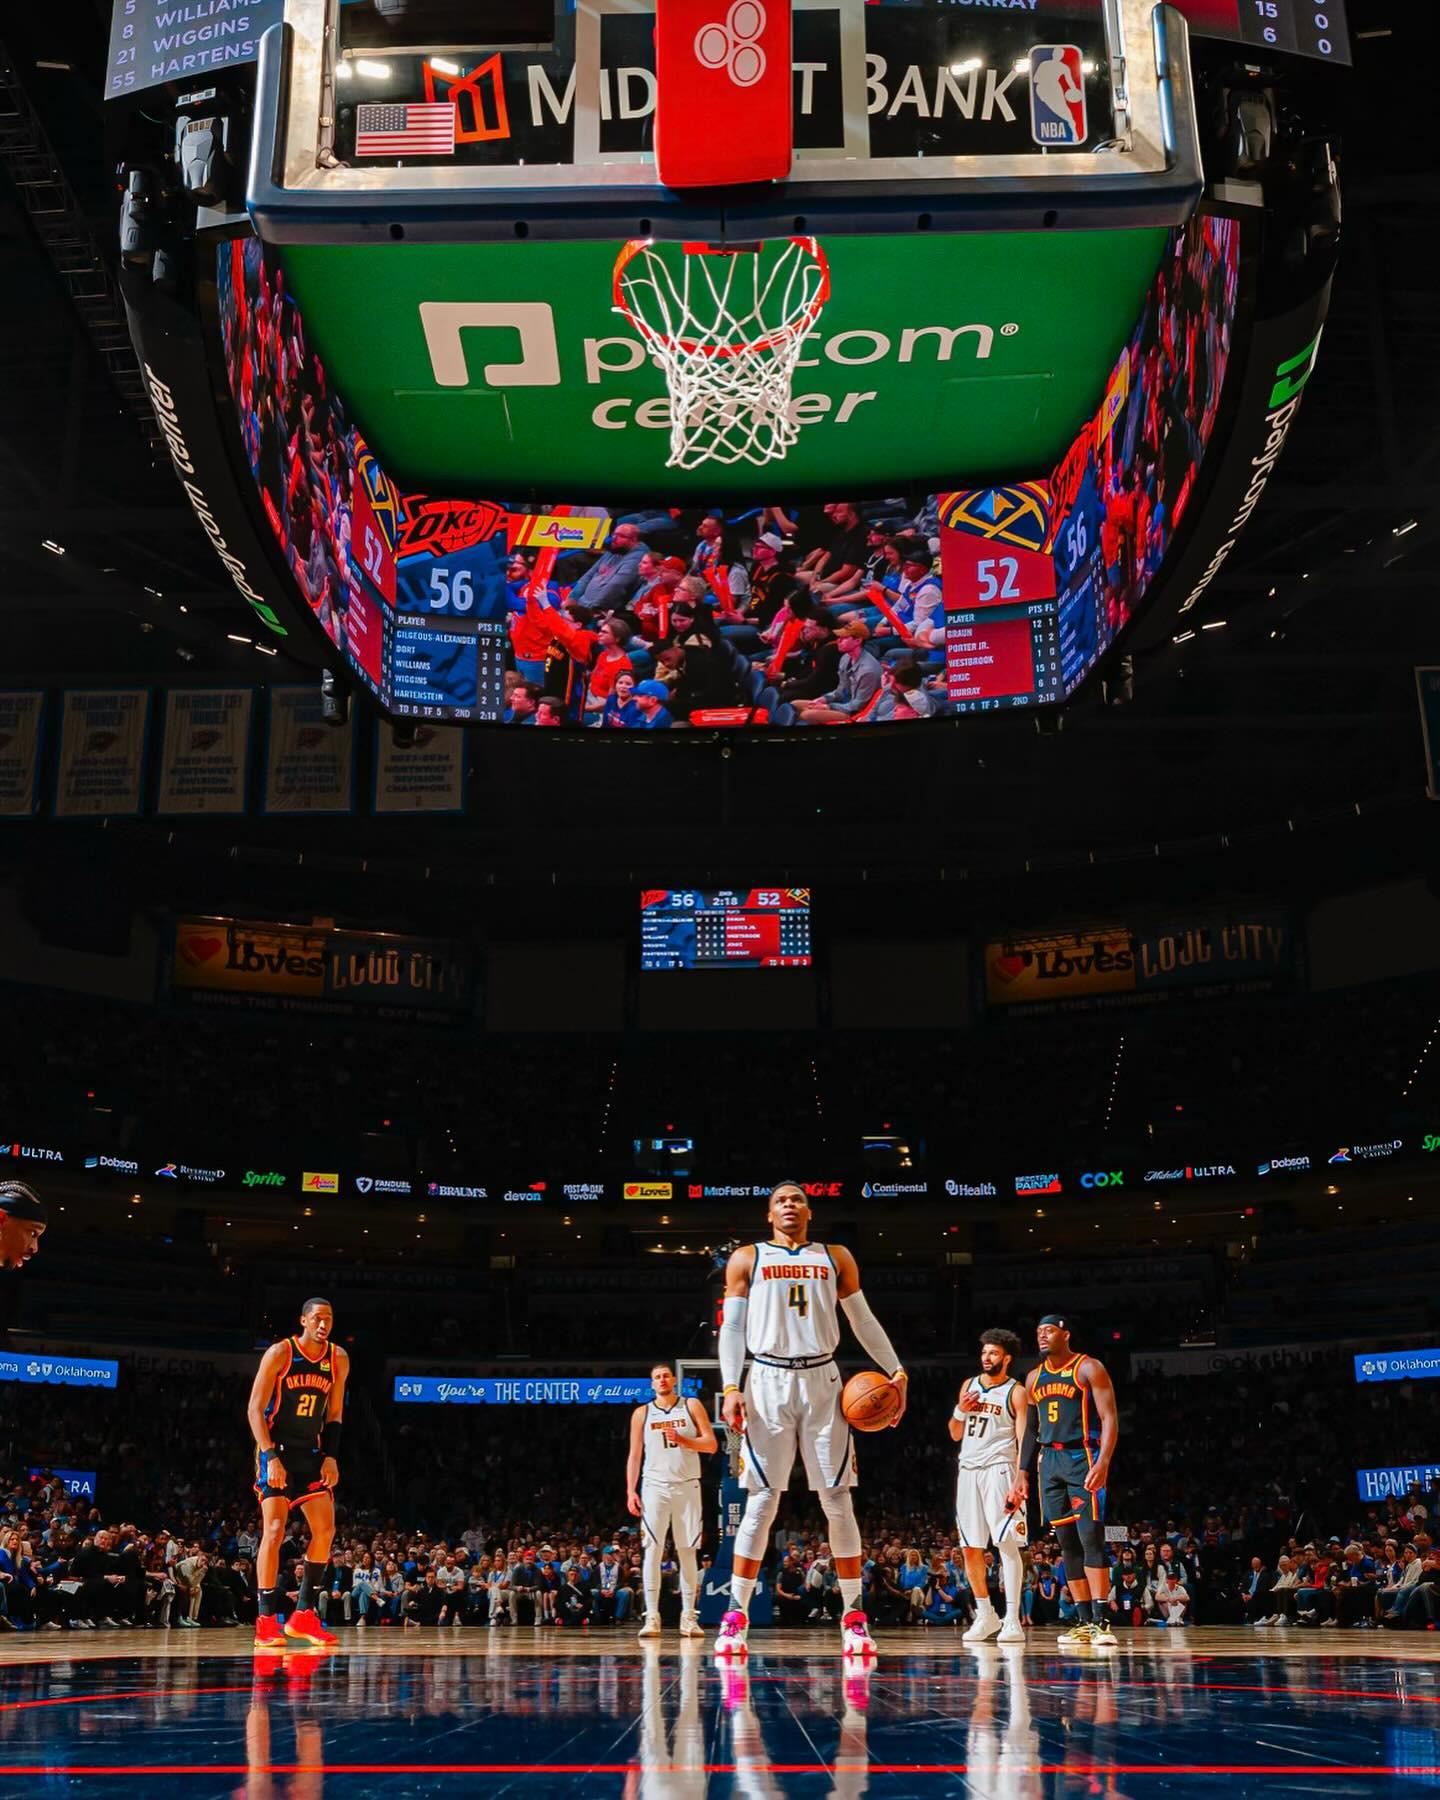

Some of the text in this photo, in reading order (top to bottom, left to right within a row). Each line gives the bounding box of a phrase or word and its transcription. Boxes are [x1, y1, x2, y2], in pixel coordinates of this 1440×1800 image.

[125, 0, 136, 15] 5
[1255, 1, 1329, 30] 15 0
[122, 24, 134, 39] 8
[116, 17, 250, 65] 21 WIGGINS
[1263, 27, 1332, 54] 6 0
[111, 71, 135, 90] 55
[866, 54, 1018, 123] BANK
[1040, 121, 1067, 140] NBA
[1227, 396, 1298, 535] paycom
[406, 508, 482, 546] OKC
[183, 480, 265, 602] paycom
[1067, 511, 1087, 572] 56
[363, 524, 383, 585] 52
[977, 556, 1020, 602] 52
[430, 568, 474, 611] 56
[947, 603, 1055, 624] PLAYER PTS FL
[398, 615, 503, 633] PLAYER PTS FL
[1032, 619, 1042, 628] 12
[1048, 618, 1053, 626] 1
[396, 630, 501, 647] GILGEOUS-ALEXANDER 17 2
[947, 642, 977, 653] PORTER
[1034, 634, 1043, 643] 11
[1048, 632, 1054, 641] 2
[482, 652, 488, 661] 3
[948, 655, 994, 668] WESTBROOK
[395, 660, 431, 671] WILLIAMS
[1035, 664, 1045, 673] 15
[1050, 662, 1056, 671] 0
[394, 674, 428, 685] WIGGINS
[481, 681, 487, 689] 4
[1051, 677, 1057, 686] 0
[394, 689, 500, 705] HARTENSTEIN 2 1
[970, 702, 976, 711] 4
[981, 700, 990, 710] TF
[993, 700, 999, 708] 3
[1012, 696, 1029, 706] 2ND
[423, 706, 433, 715] TF
[455, 708, 471, 719] 2ND
[480, 711, 497, 721] 2:18
[672, 893, 694, 907] 56
[757, 892, 781, 906] 52
[713, 897, 739, 906] 2:18
[21, 1146, 64, 1161] ULTRA
[100, 1156, 138, 1170] Dobson
[1271, 1156, 1310, 1169] Dobson
[1194, 1165, 1236, 1177] ULTRA
[242, 1170, 287, 1188] Sprite
[375, 1180, 412, 1189] FANDUEL
[1016, 1181, 1049, 1191] PAINT
[1080, 1171, 1124, 1188] COX
[563, 1184, 580, 1194] POST
[753, 1185, 773, 1196] BAN
[872, 1182, 927, 1193] Continental
[959, 1182, 996, 1197] Health
[504, 1190, 541, 1201] devon
[569, 1192, 599, 1200] TOYOTA
[761, 1265, 829, 1281] NUGGETS
[787, 1284, 808, 1320] 4
[55, 1365, 111, 1379] Oklahoma
[437, 1383, 486, 1400] You're
[494, 1382, 521, 1401] THE
[525, 1382, 580, 1401] CENTER
[587, 1385, 601, 1400] of
[604, 1386, 622, 1397] all
[624, 1387, 641, 1397] we
[296, 1393, 318, 1417] 21
[971, 1401, 1002, 1416] GGETS
[1047, 1401, 1059, 1423] 5
[967, 1415, 989, 1439] 27
[64, 1479, 93, 1494] RA
